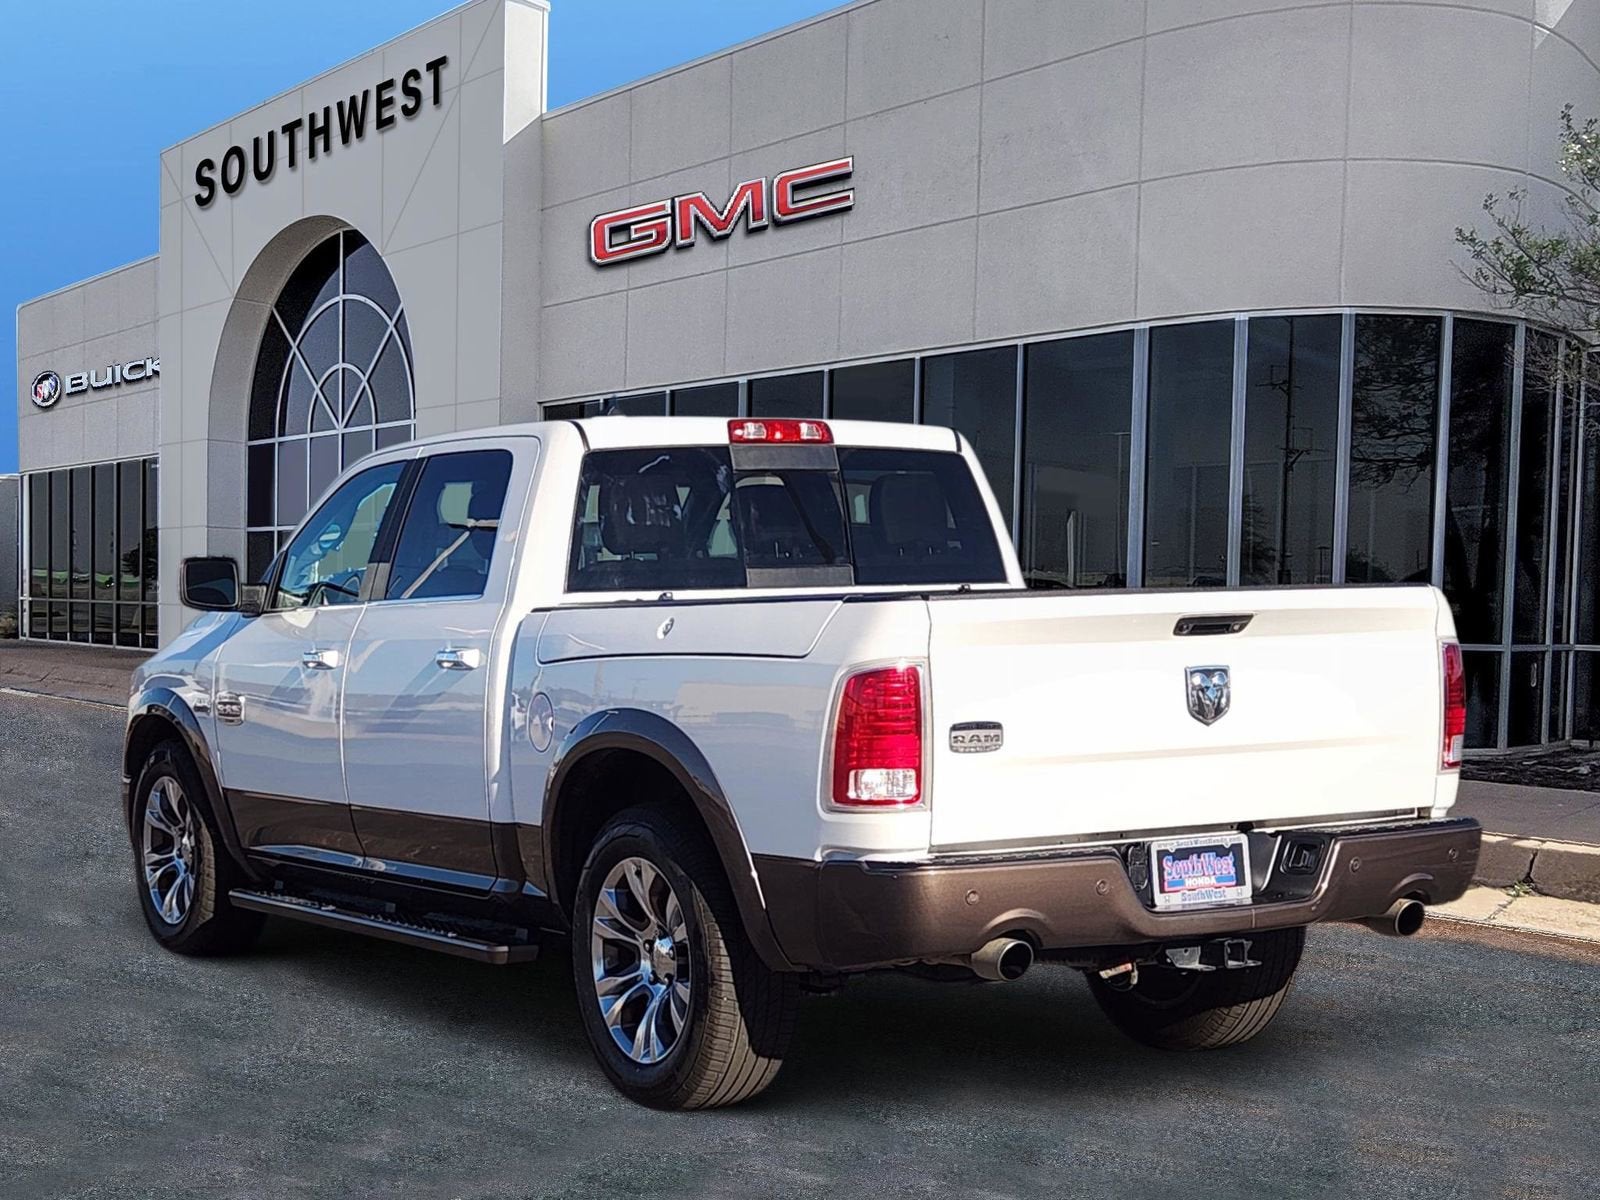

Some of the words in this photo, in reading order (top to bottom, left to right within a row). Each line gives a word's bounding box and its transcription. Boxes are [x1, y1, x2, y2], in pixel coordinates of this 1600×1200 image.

[194, 55, 448, 207] SOUTHWEST
[589, 156, 855, 266] GMC
[64, 357, 160, 395] BUICK
[1184, 875, 1216, 887] HONDA
